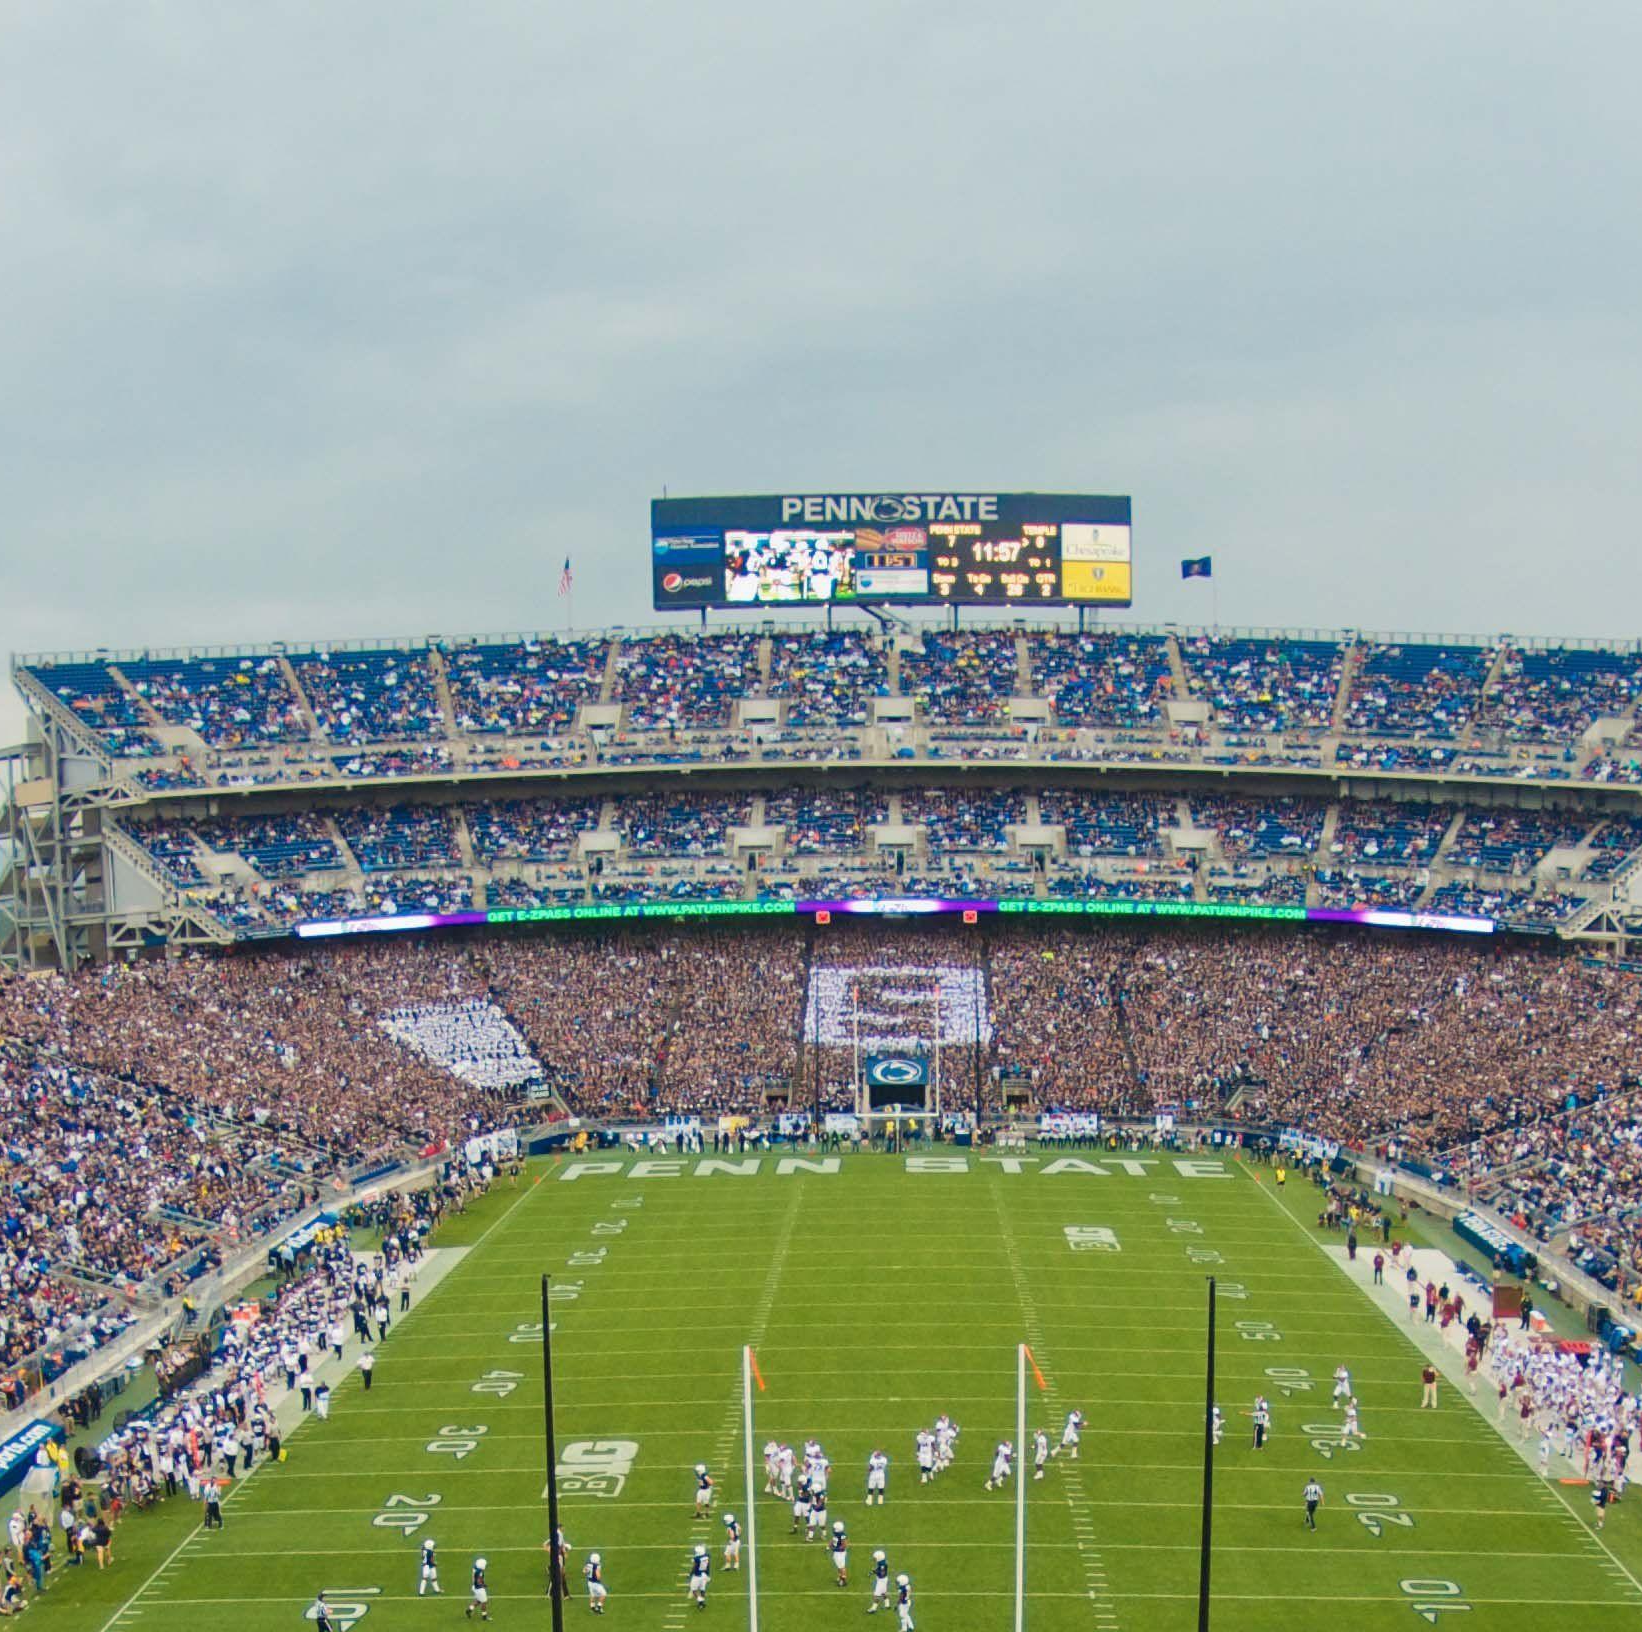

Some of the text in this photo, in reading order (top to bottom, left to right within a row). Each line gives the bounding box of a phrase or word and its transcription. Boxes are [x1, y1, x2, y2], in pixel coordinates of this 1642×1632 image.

[782, 496, 998, 522] PENN STATE
[972, 541, 1021, 562] 11:57
[487, 902, 795, 923] GET E-ZPASS ONLINE AT WWW.PATURNPIKE.COM
[998, 901, 1306, 919] GET E-ZPASS ONLINE AT WWW.PATURNPIKE.COM
[559, 1157, 1234, 1181] PENN STATE
[1235, 1321, 1282, 1341] 50
[470, 1369, 525, 1394] 40
[1264, 1366, 1317, 1391] 40
[426, 1424, 488, 1455] 30
[372, 1492, 443, 1529] 20
[1344, 1492, 1414, 1528] 20
[1399, 1578, 1472, 1612] 10
